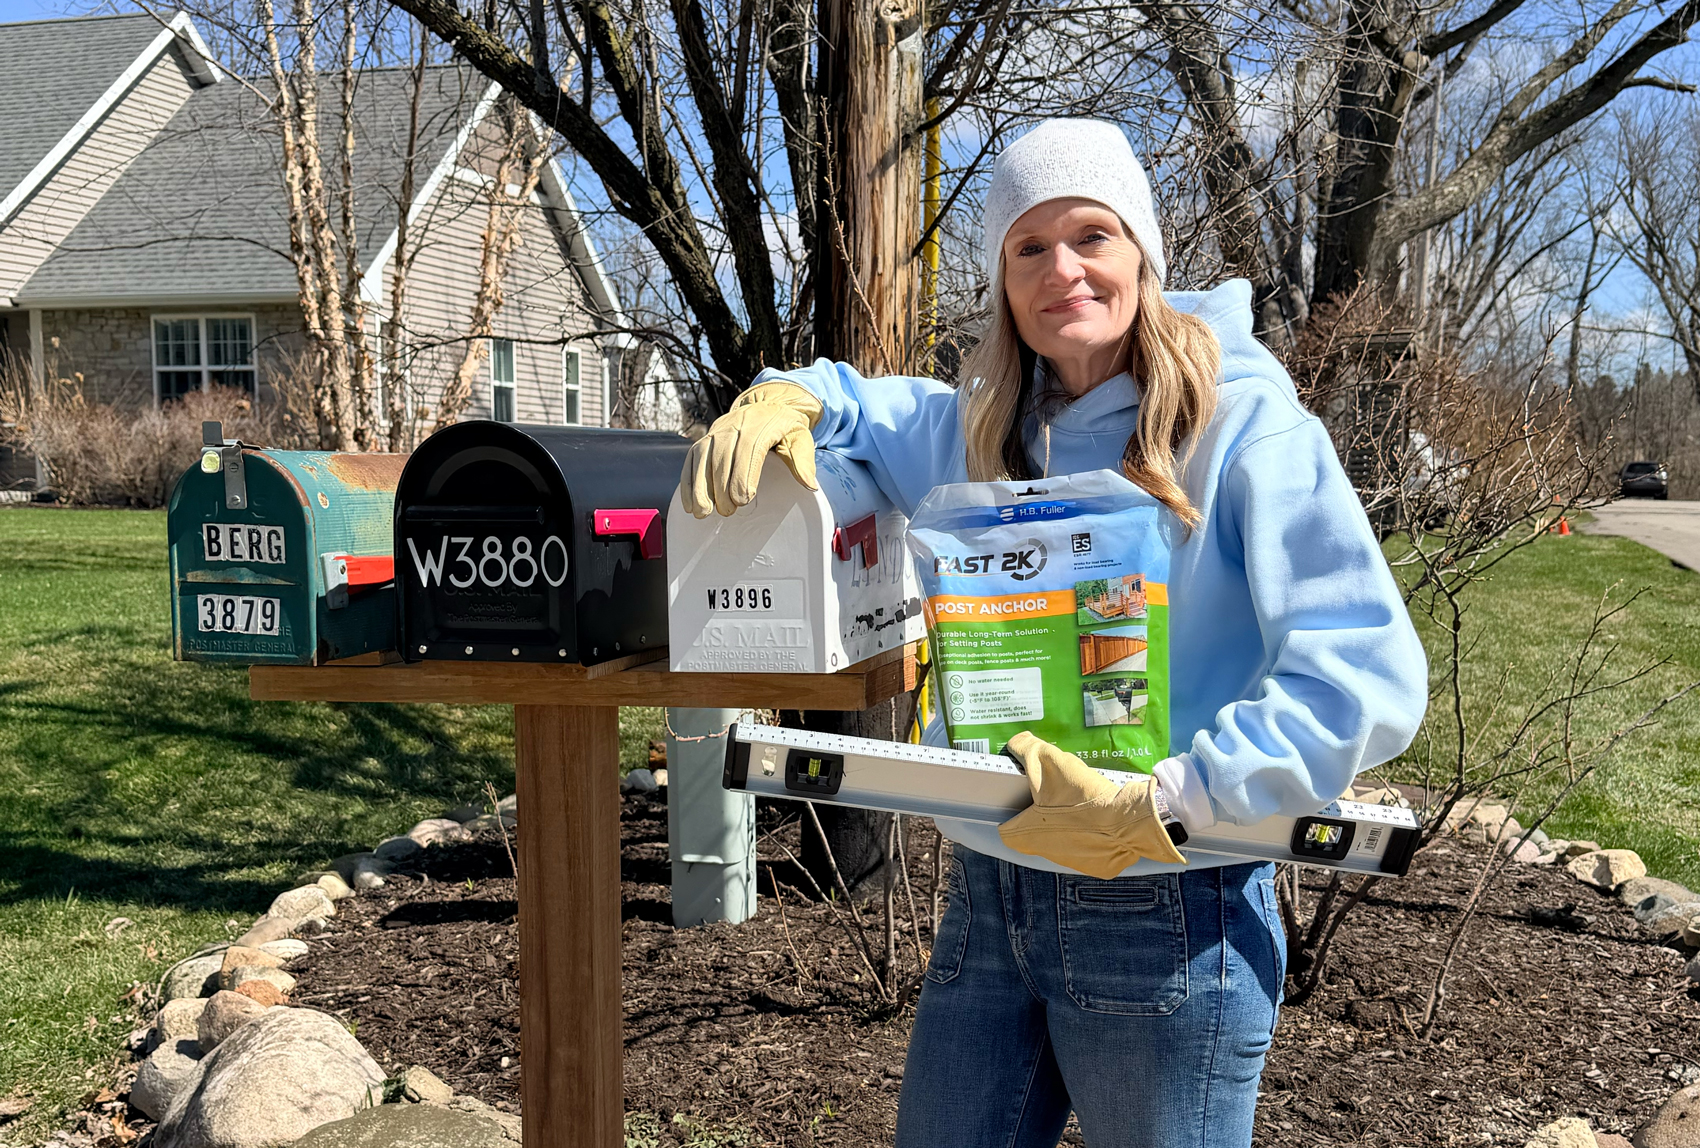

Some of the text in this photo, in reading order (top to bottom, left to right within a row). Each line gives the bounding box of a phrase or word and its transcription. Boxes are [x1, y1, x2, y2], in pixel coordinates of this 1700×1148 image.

[1040, 506, 1066, 514] Fuller
[206, 525, 282, 562] BERG
[1073, 538, 1090, 551] ES
[406, 535, 568, 588] W3880
[934, 548, 1036, 574] FAST 2K
[707, 588, 772, 610] W3896
[935, 598, 1048, 615] POST ANCHOR
[202, 598, 275, 632] 3879
[734, 626, 810, 648] MAIL
[968, 630, 1013, 638] Long-Term
[1015, 627, 1048, 636] Solution
[700, 650, 796, 660] APPROVED BY THE
[688, 662, 809, 671] POSTMASTER GENERAL
[1076, 750, 1098, 759] 33.8
[1101, 749, 1108, 758] fl
